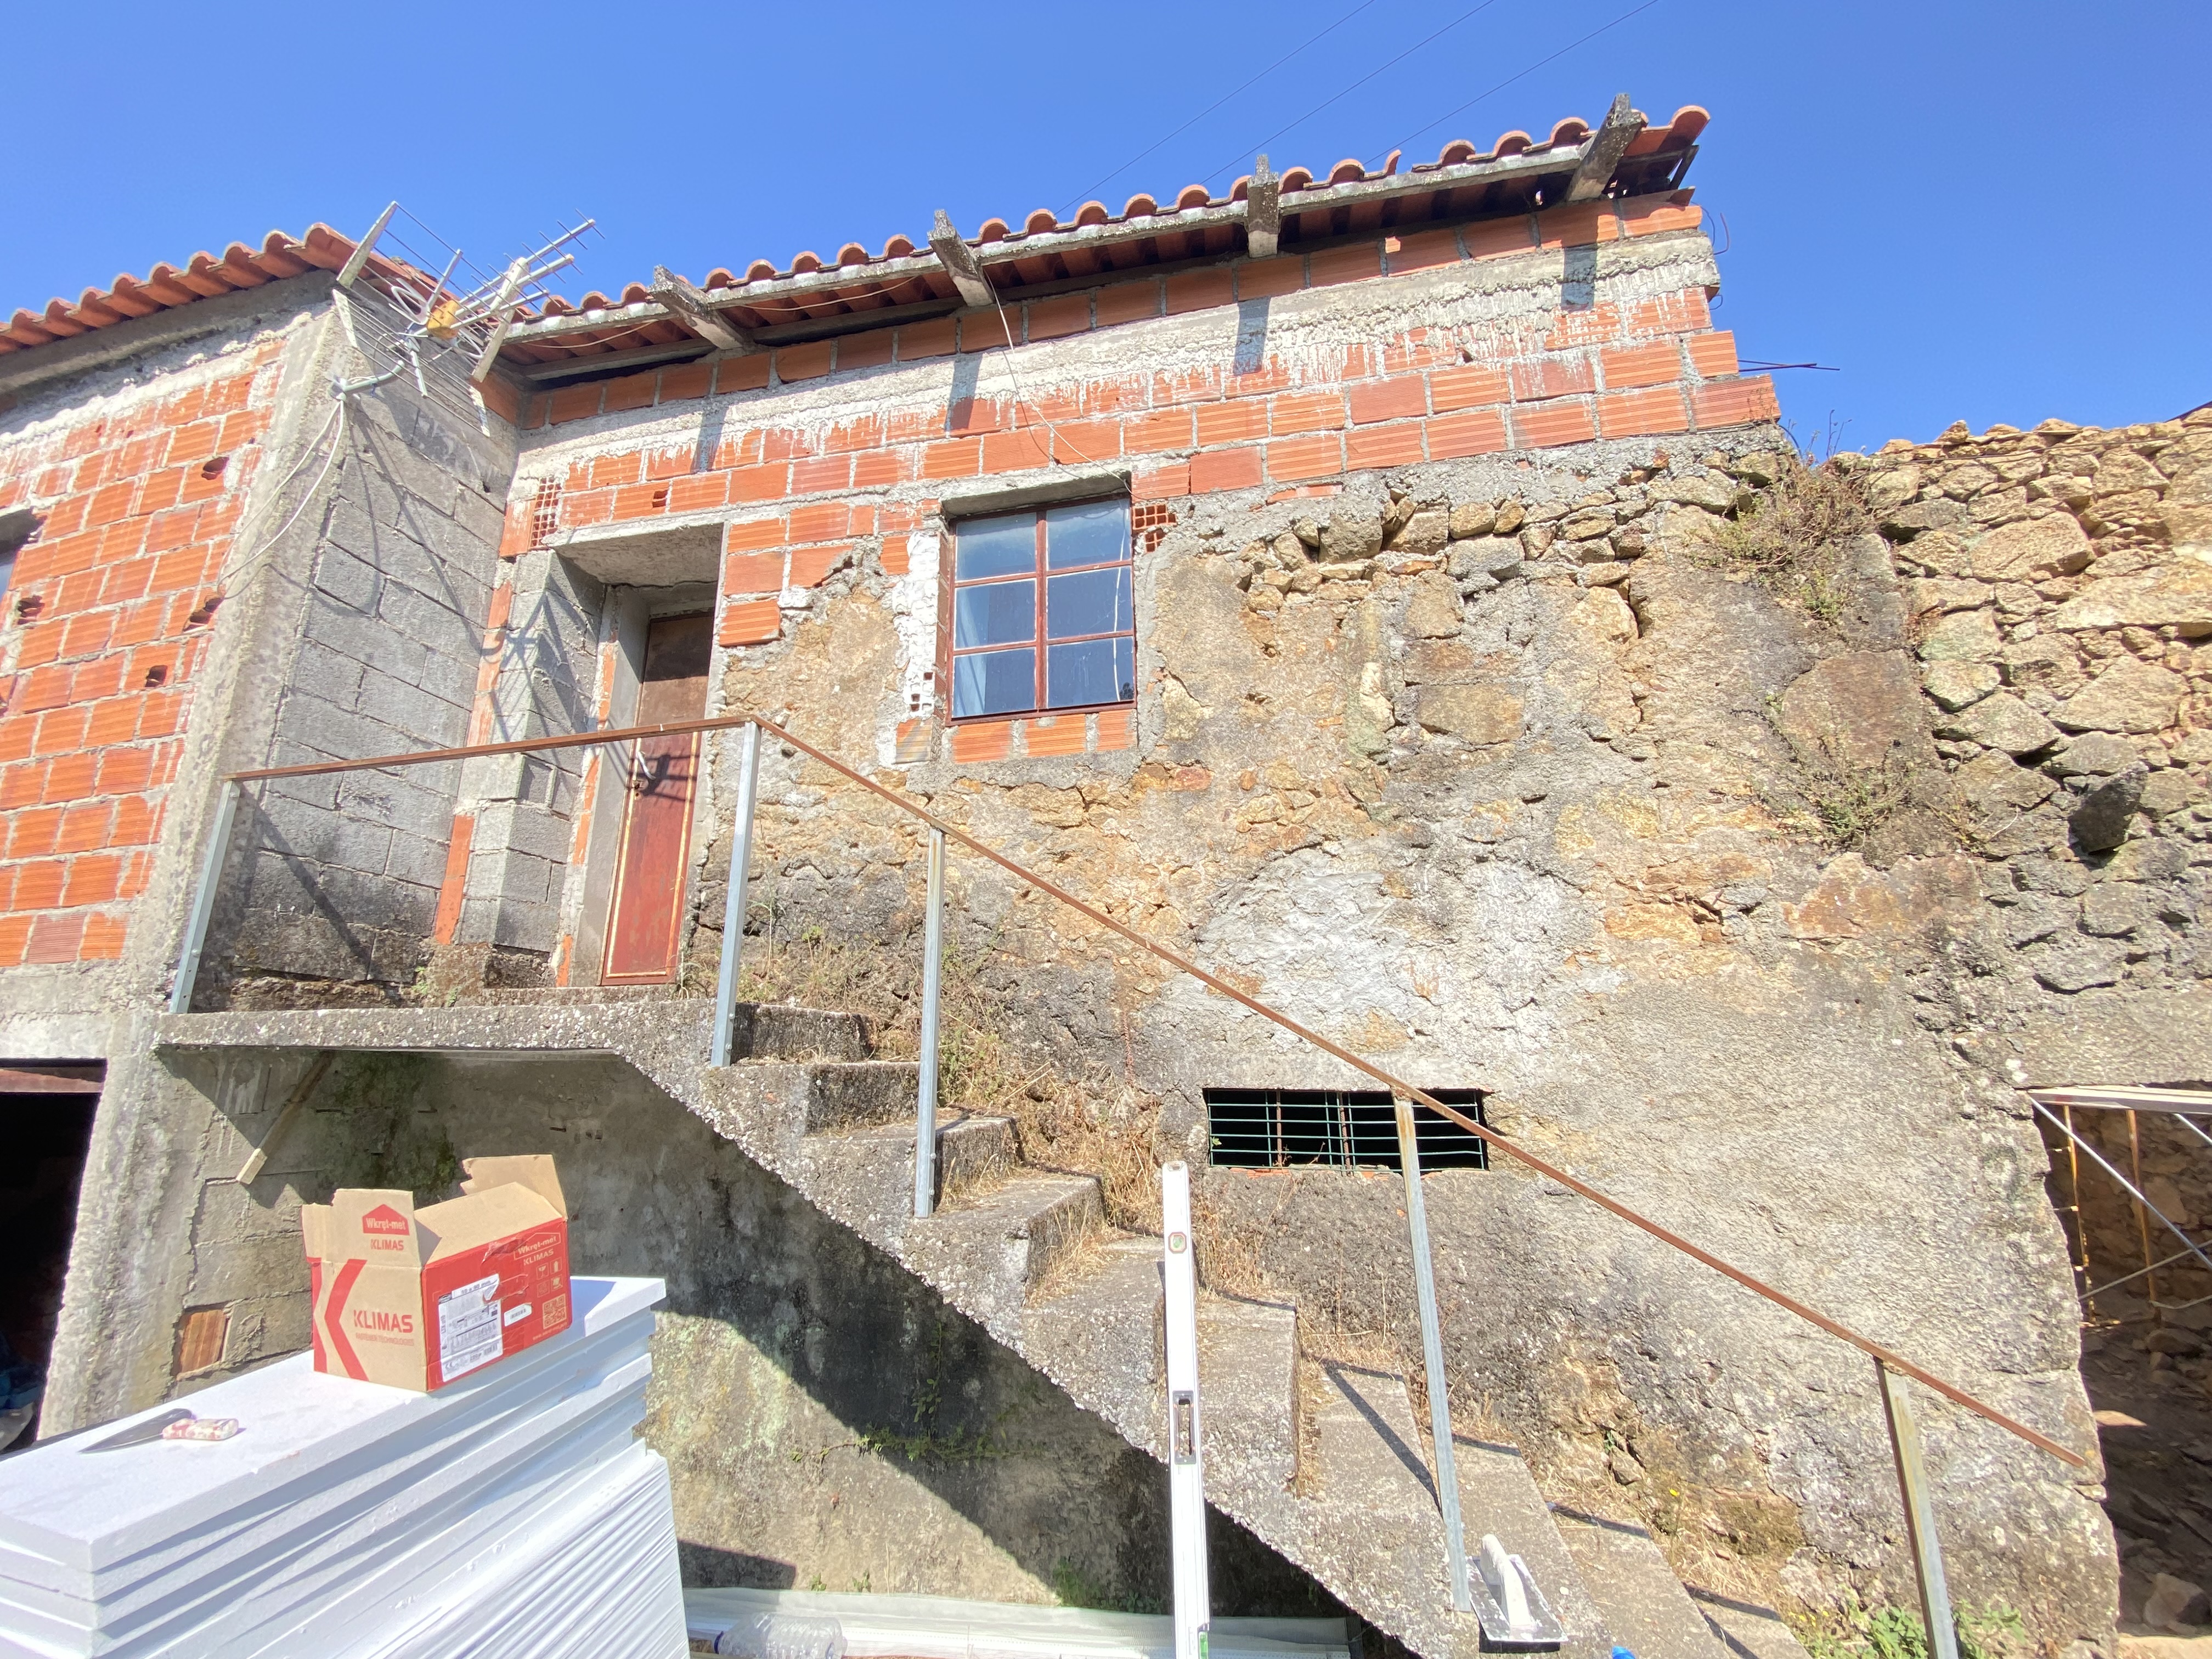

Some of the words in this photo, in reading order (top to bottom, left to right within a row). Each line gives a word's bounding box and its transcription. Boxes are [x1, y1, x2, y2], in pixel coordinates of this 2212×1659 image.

[370, 1239, 404, 1251] KLIMAS
[523, 1248, 554, 1266] KLIMAS
[353, 1310, 414, 1333] KLIMAS
